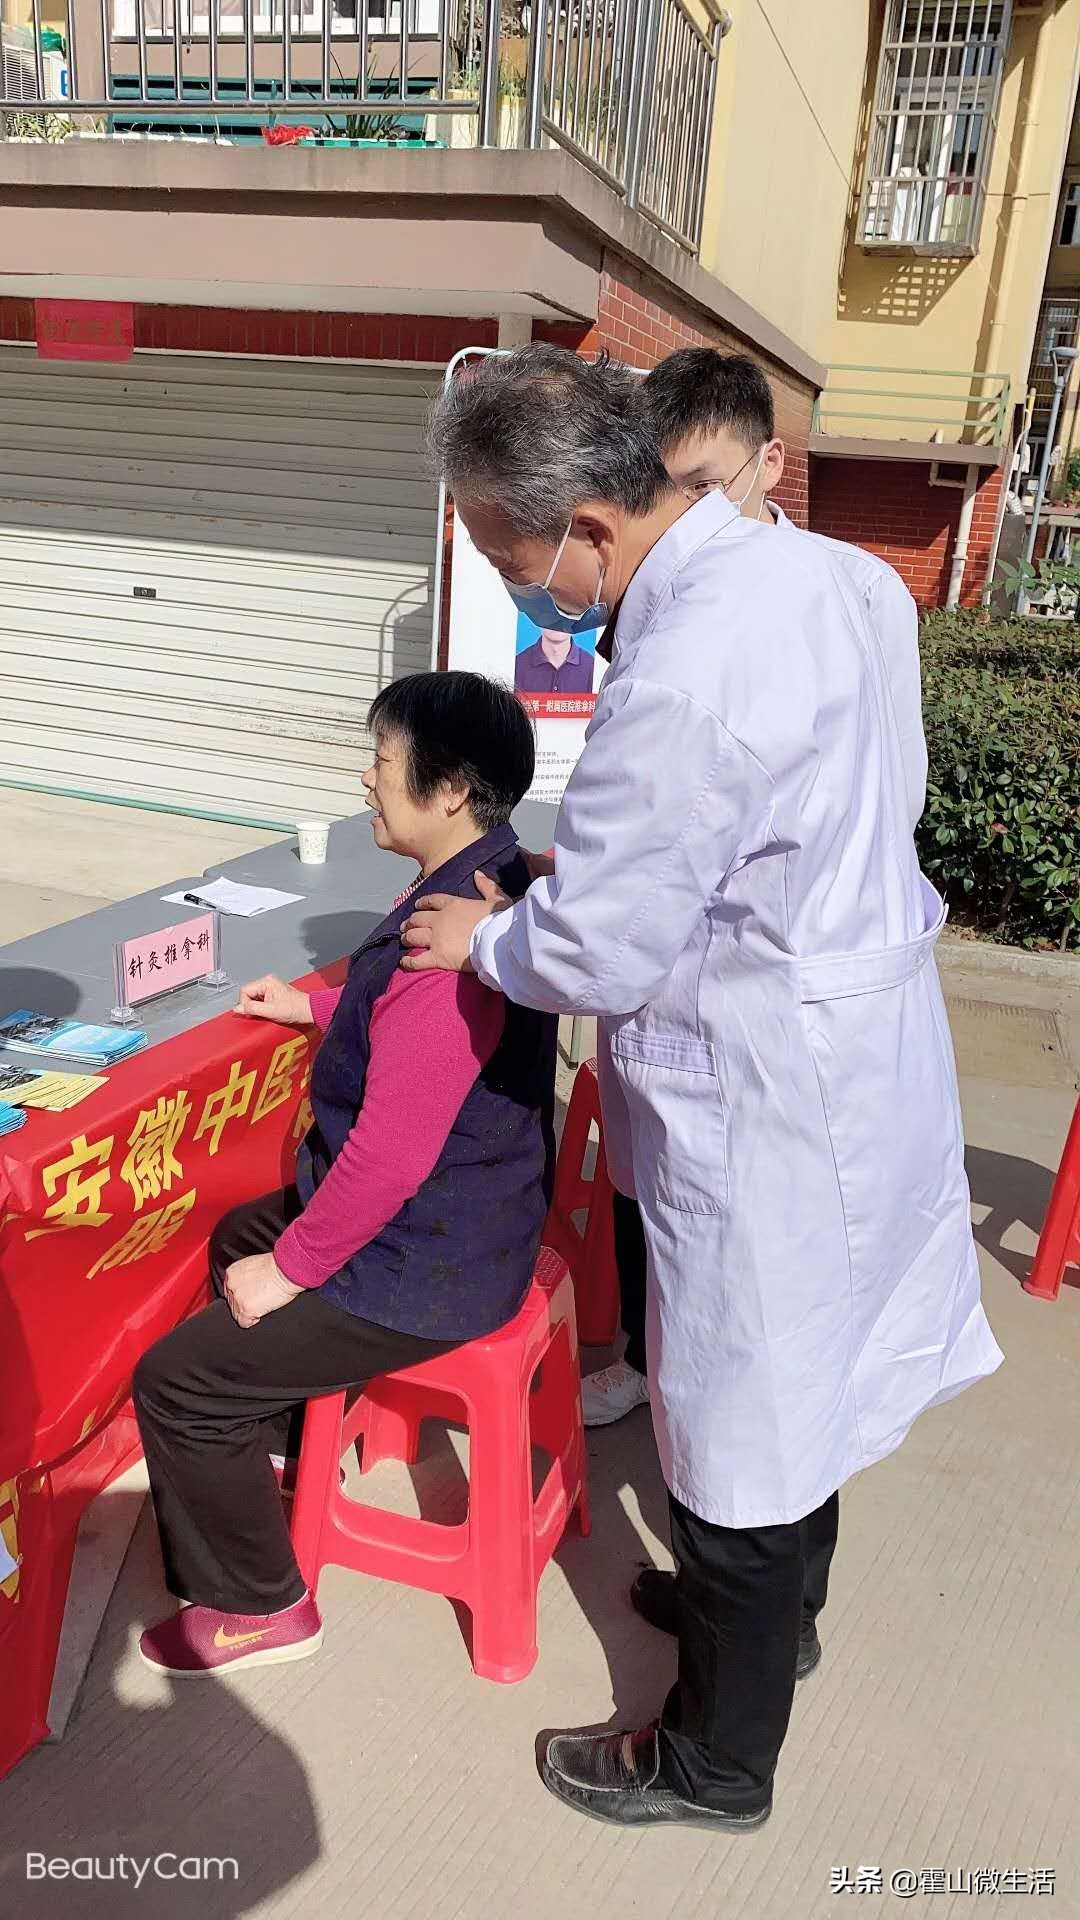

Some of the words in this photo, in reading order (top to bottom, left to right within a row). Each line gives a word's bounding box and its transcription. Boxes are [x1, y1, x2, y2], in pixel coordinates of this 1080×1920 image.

[127, 929, 211, 980] 针灸推拿科
[25, 1034, 310, 1242] 安徽中医
